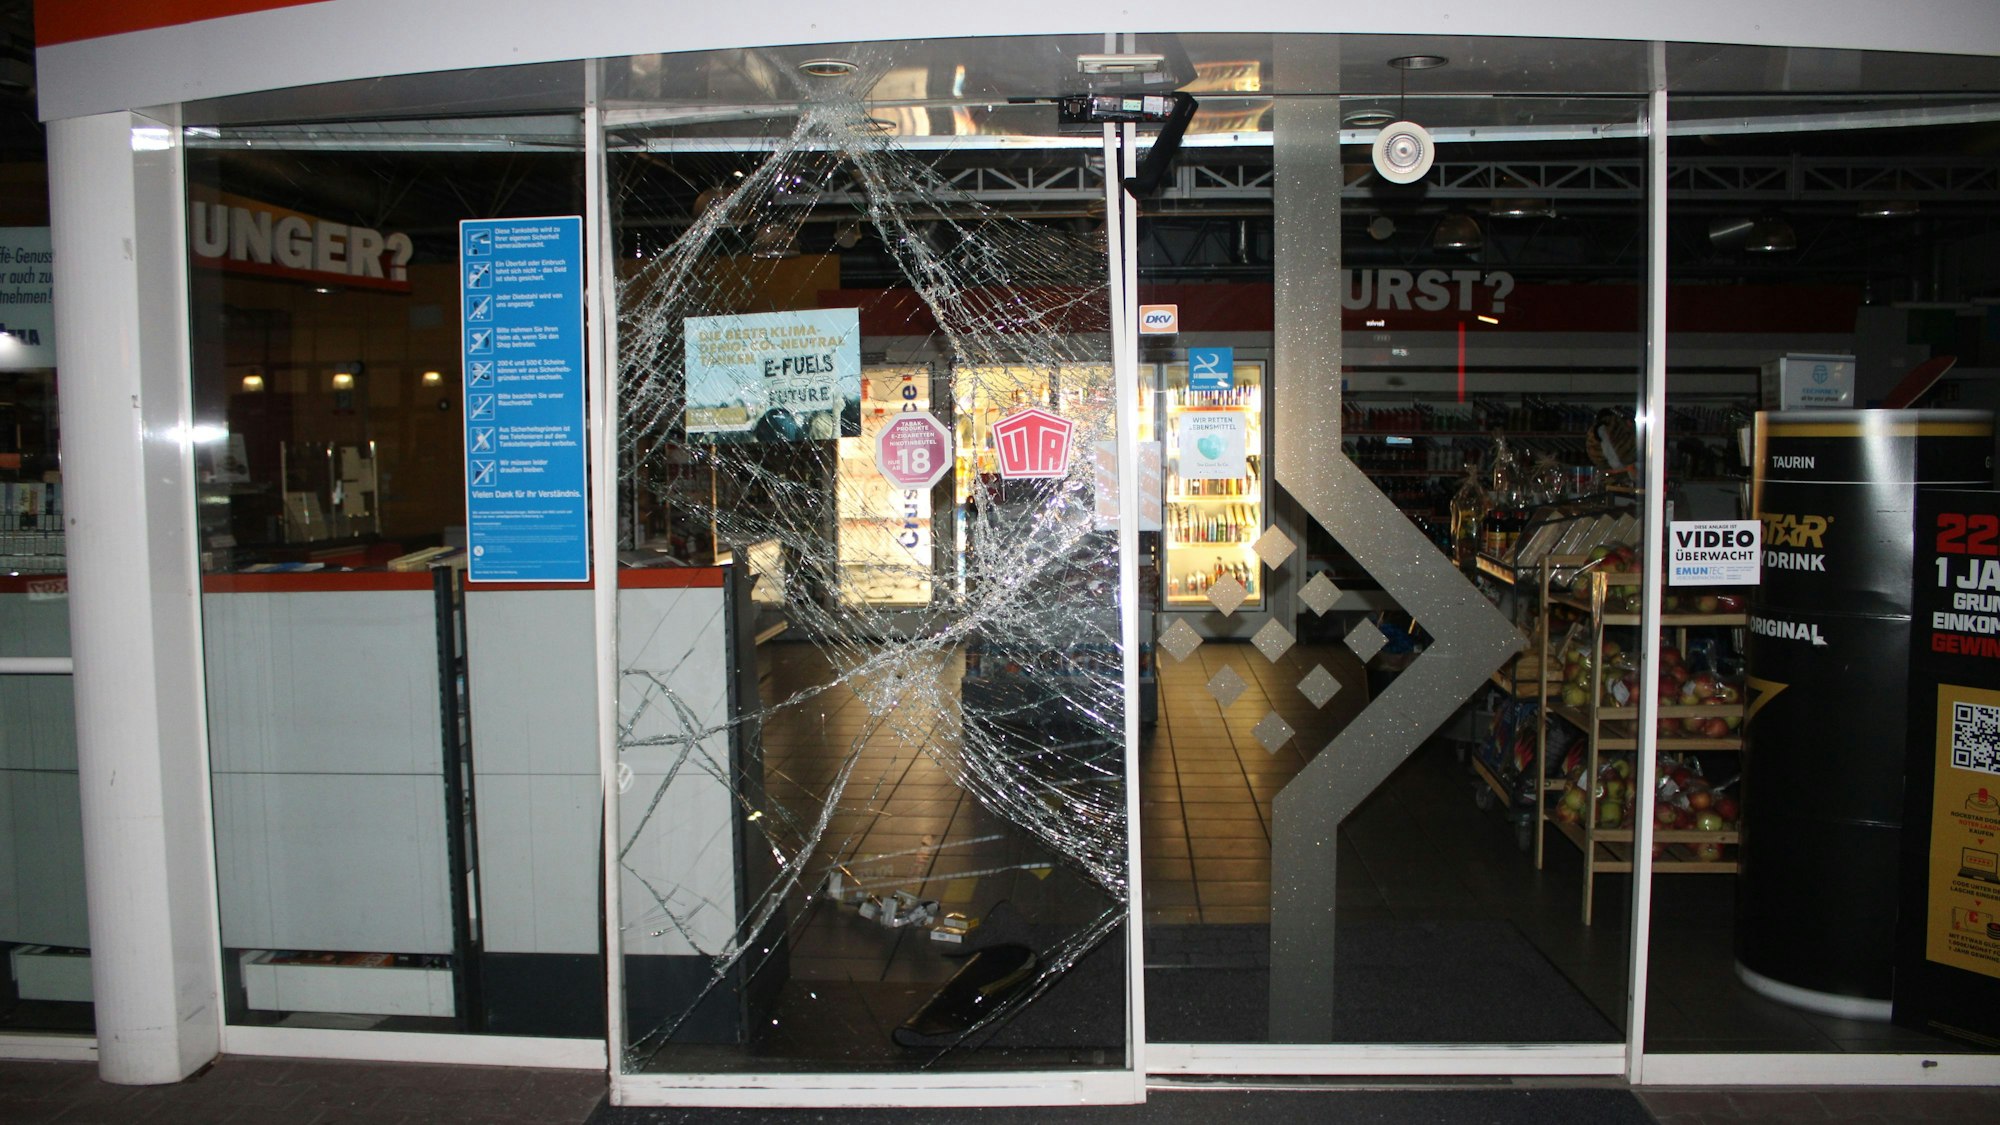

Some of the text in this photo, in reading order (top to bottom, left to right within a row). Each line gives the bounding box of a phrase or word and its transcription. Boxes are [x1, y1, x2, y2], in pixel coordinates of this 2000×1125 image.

[193, 201, 413, 282] UNGER?
[10, 266, 35, 284] auch
[39, 272, 54, 284] zu
[1145, 315, 1172, 324] DKV
[699, 325, 820, 341] DIE BESTE KLIMA-
[700, 354, 756, 367] TANKEN
[764, 354, 834, 378] E-FUELS
[768, 387, 831, 406] FUTURE
[1000, 414, 1067, 471] UTA
[896, 448, 931, 474] 18
[1772, 456, 1815, 469] TAURIN
[495, 490, 514, 498] Dank
[515, 490, 525, 498] für
[526, 490, 536, 498] Ihr
[538, 490, 582, 498] Verständnis.
[1676, 530, 1754, 548] VIDEO
[1936, 512, 2000, 556] 22
[1676, 549, 1754, 561] ÜBERWACHT
[1768, 550, 1825, 572] DRINK
[1676, 566, 1724, 575] EMUNTEC
[1935, 556, 1948, 588] 1
[1751, 616, 1828, 646] ORIGINAL
[1968, 828, 1994, 838] KAUFEN
[1950, 886, 1974, 896] LASCHE
[1952, 880, 1970, 888] CODE
[1970, 884, 1992, 892] UNTER
[1961, 935, 1982, 945] ETWAS
